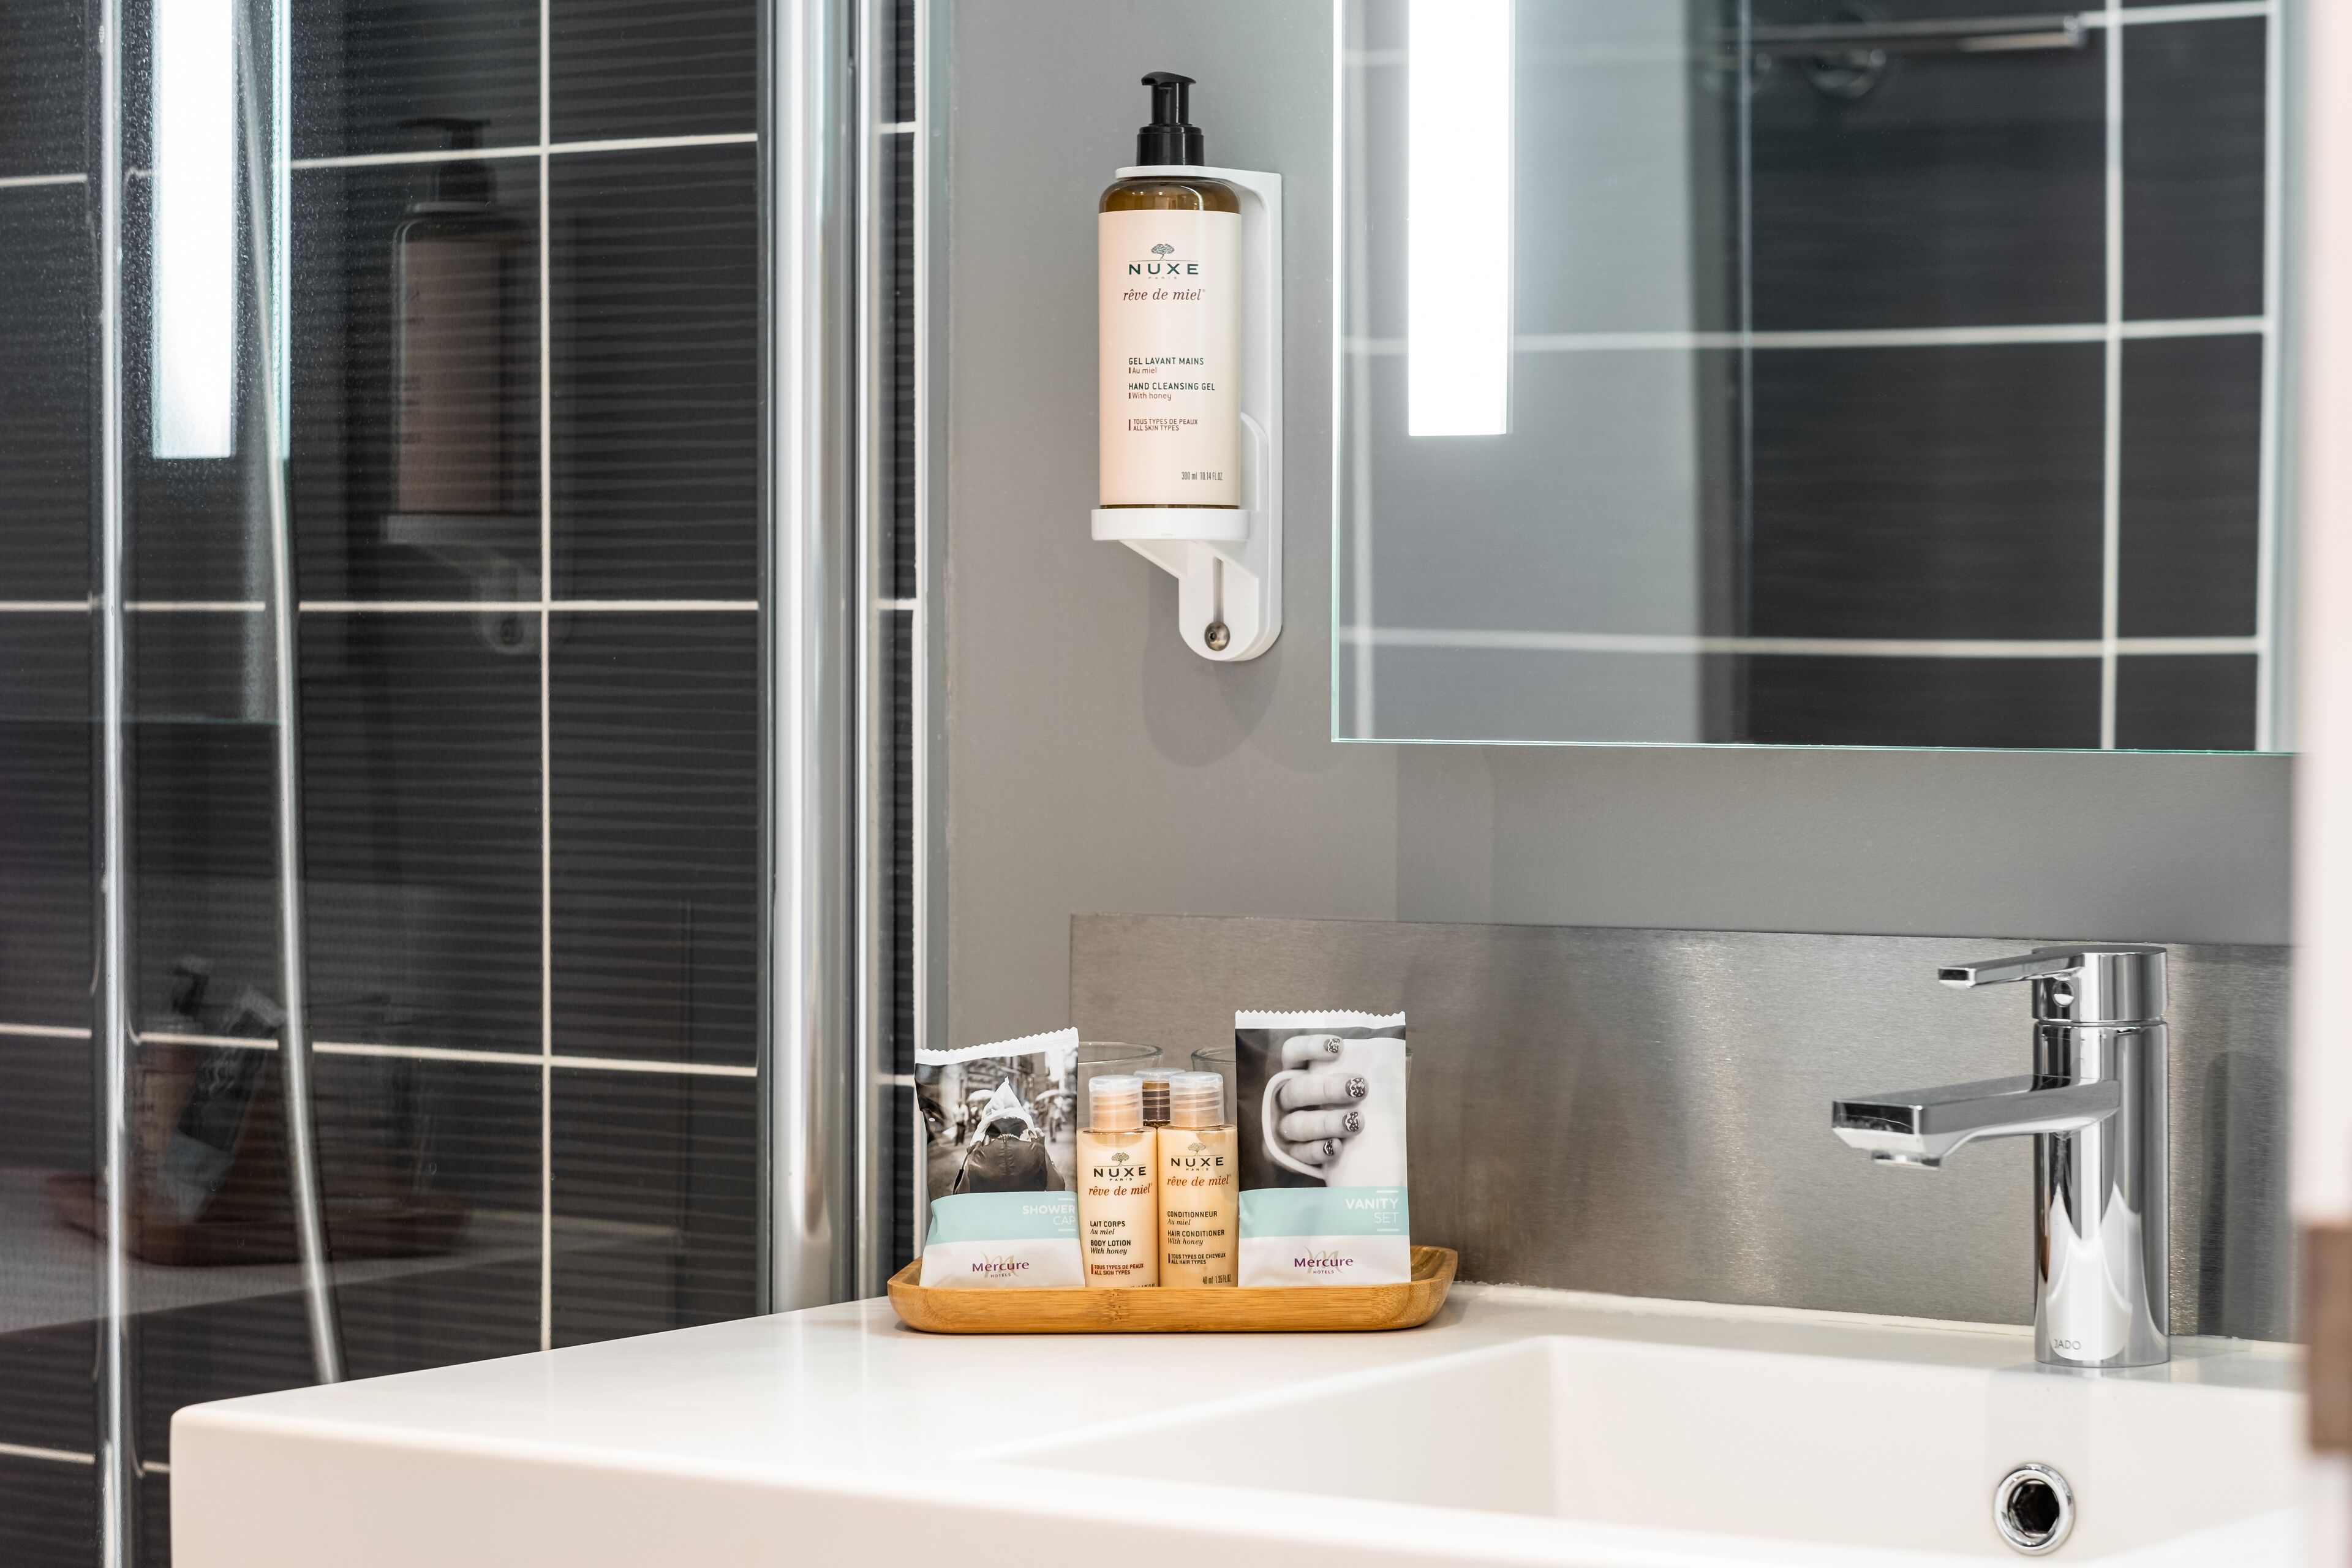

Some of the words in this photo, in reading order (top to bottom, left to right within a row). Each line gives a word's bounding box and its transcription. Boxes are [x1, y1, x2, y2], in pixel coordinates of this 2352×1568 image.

[1128, 263, 1199, 275] NUXE
[1123, 288, 1148, 301] rêve
[1152, 288, 1168, 300] de
[1149, 392, 1172, 401] honey
[1182, 472, 1191, 480] 300
[1191, 472, 1197, 480] ml
[1200, 472, 1212, 480] 10.14
[1170, 1157, 1224, 1167] NUXE
[1093, 1166, 1147, 1177] NUXE
[1167, 1176, 1187, 1186] rêve
[1191, 1176, 1205, 1186] de
[1088, 1186, 1110, 1196] rêve
[1114, 1186, 1127, 1196] de
[1345, 1198, 1399, 1209] VANITY
[1022, 1204, 1076, 1214] SHOWER
[1053, 1216, 1076, 1226] CAP
[1373, 1212, 1400, 1223] SET
[972, 1262, 1030, 1272] Mercure
[1294, 1257, 1354, 1267] Mercure
[1202, 1276, 1208, 1284] 40
[2054, 1339, 2081, 1350] JADO
